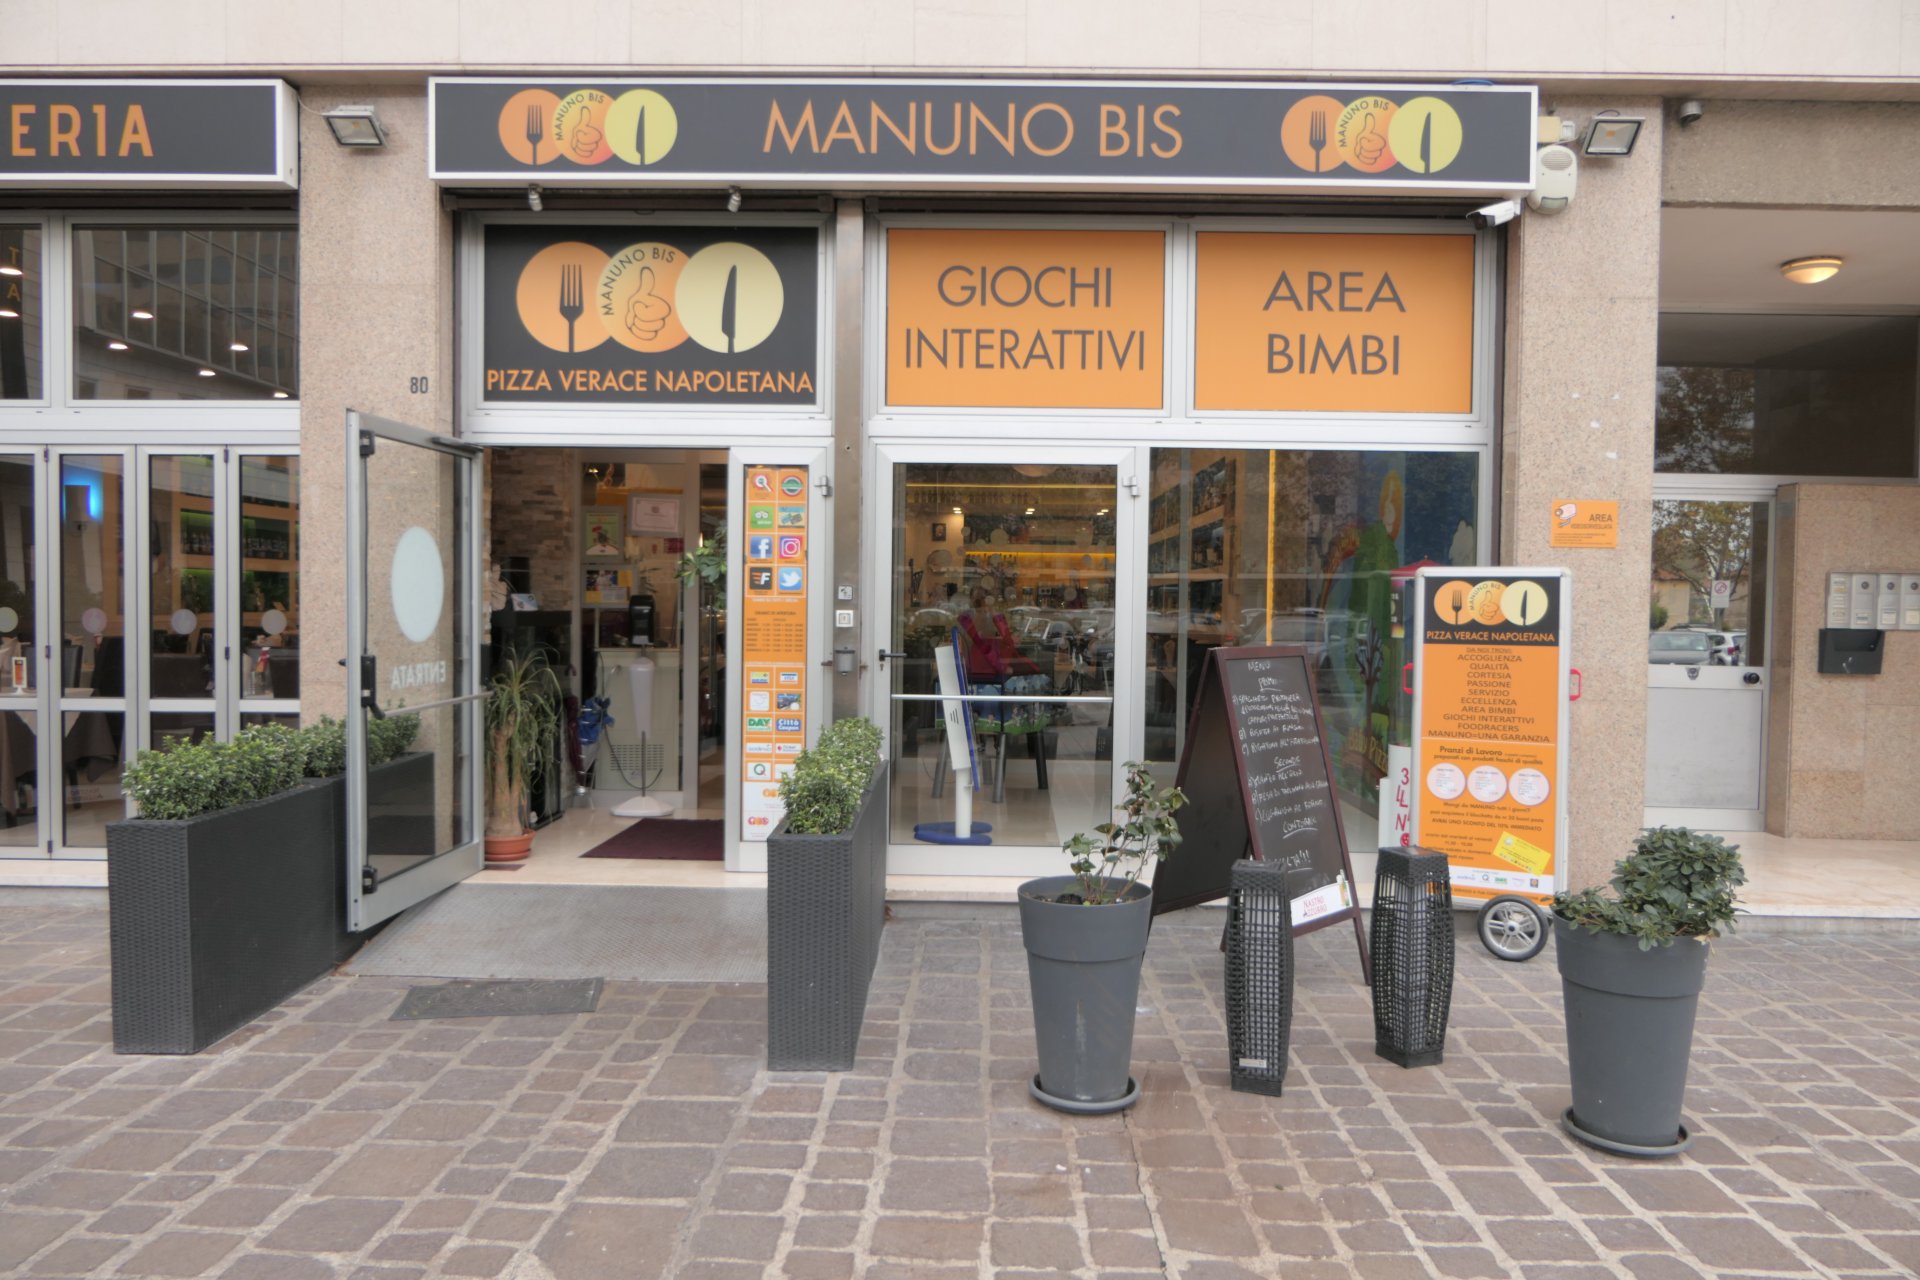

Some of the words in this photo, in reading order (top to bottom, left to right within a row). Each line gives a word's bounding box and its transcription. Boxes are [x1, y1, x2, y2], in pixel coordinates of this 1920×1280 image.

[553, 93, 584, 142] MANUNO
[587, 91, 605, 104] BIS
[762, 98, 1075, 158] MANUNO
[1098, 103, 1184, 159] BIS
[1337, 101, 1370, 148] MANUNO
[1372, 99, 1390, 111] BIS
[601, 250, 647, 317] MANUNO
[651, 247, 676, 264] BIS
[936, 264, 1113, 308] GIOCHI
[1261, 270, 1407, 314] AREA
[905, 327, 1146, 372] INTERATTIVI
[1266, 333, 1401, 376] BIMBI
[409, 376, 429, 395] 80
[486, 369, 552, 392] PIZZA
[558, 369, 649, 393] VERACE
[655, 370, 814, 395] NAPOLETANA
[1588, 513, 1613, 522] AREA
[1469, 583, 1488, 611] MANUNO
[1426, 630, 1452, 640] PIZZA
[1454, 631, 1489, 641] VERACE
[1491, 632, 1556, 642] NAPOLETANA
[1457, 654, 1523, 662] ACCOGLIENZA
[1466, 671, 1512, 680] CORTESIA
[1466, 680, 1511, 688] PASSIONE
[1468, 688, 1510, 697] SERVIZIO
[1460, 697, 1517, 706] ECCELLENZA
[1461, 705, 1486, 713] AREA
[1488, 706, 1516, 715] BIMBI
[748, 718, 770, 727] DAY
[1443, 713, 1476, 722] GIOCHI
[1478, 714, 1535, 725] INTERATTIVI
[1457, 722, 1519, 732] FOODRACERS
[1501, 733, 1550, 743] GARANZIA
[1439, 745, 1464, 754] Pranzi
[1476, 748, 1504, 757] Lavoro
